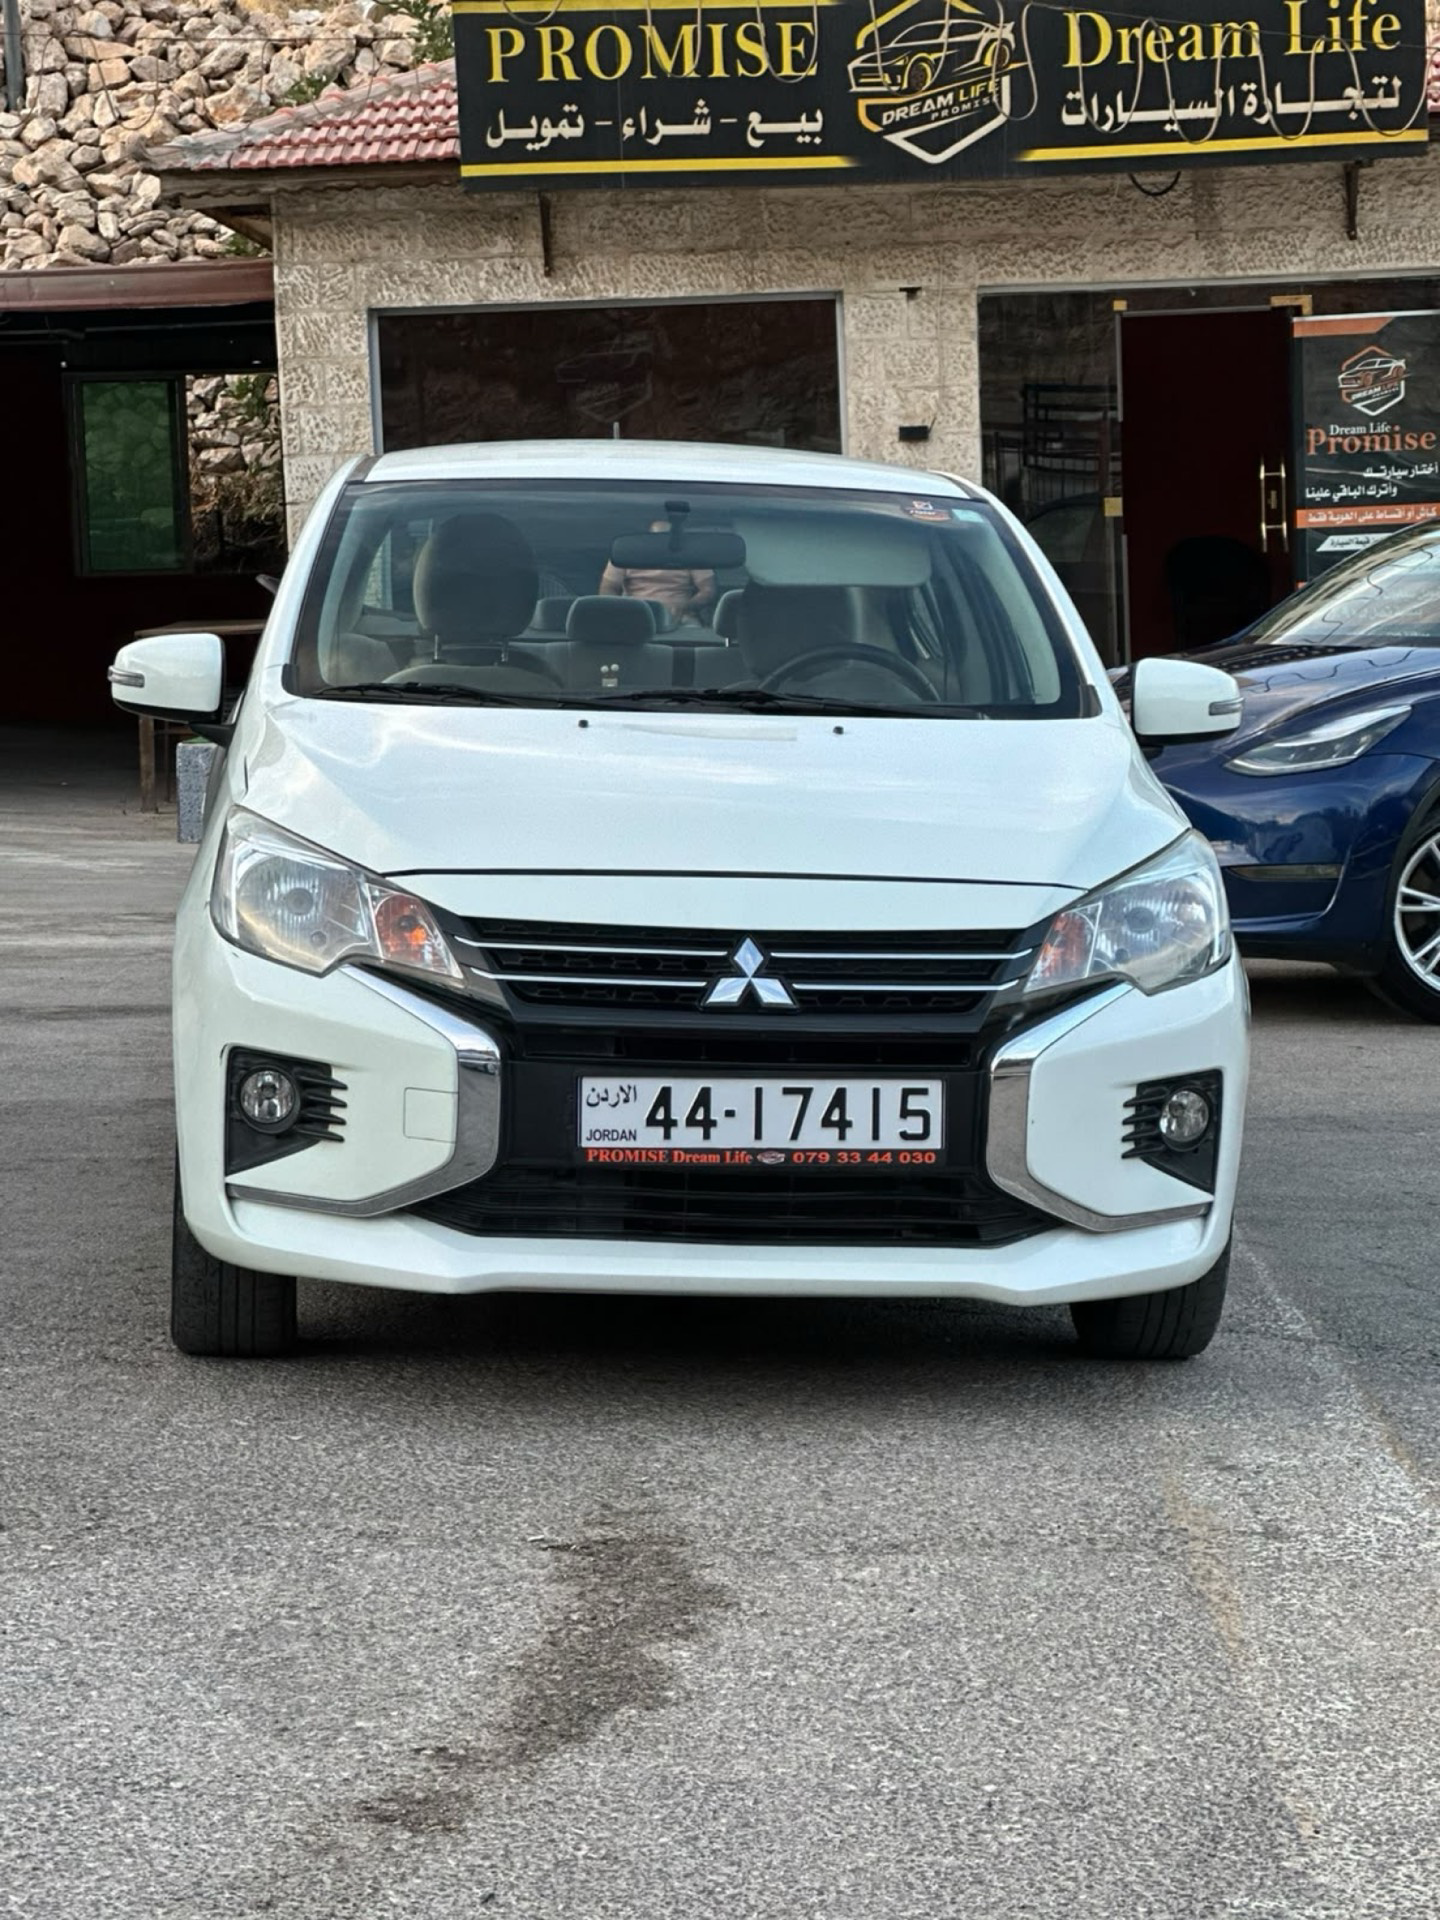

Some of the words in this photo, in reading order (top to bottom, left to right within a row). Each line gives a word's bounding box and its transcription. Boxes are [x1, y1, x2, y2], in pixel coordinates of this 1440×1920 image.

[485, 21, 819, 83] PROMISE
[1062, 11, 1262, 67] Dream
[1284, 0, 1401, 56] Life
[882, 92, 954, 126] DREAM
[959, 79, 1000, 102] LIFE
[1061, 85, 1235, 132] السيارات
[1242, 75, 1402, 125] لتجارة
[486, 104, 585, 151] تمويل
[622, 98, 712, 146] شراء
[746, 108, 824, 147] بيع
[1307, 426, 1437, 456] Promise
[1330, 424, 1367, 435] Dream
[1370, 422, 1392, 433] Life
[1363, 465, 1409, 480] سيارتك
[1305, 487, 1331, 502] علينا
[1332, 484, 1366, 502] الباقي
[586, 1084, 638, 1109] الاردن
[645, 1086, 931, 1142] 44-17415
[586, 1129, 637, 1142] JORDAN
[587, 1148, 669, 1163] PROMISE
[672, 1150, 721, 1163] Dream
[724, 1151, 753, 1164] Life
[792, 1152, 831, 1163] 079
[836, 1152, 861, 1163] 33
[867, 1152, 893, 1163] 44
[899, 1152, 936, 1163] 030
